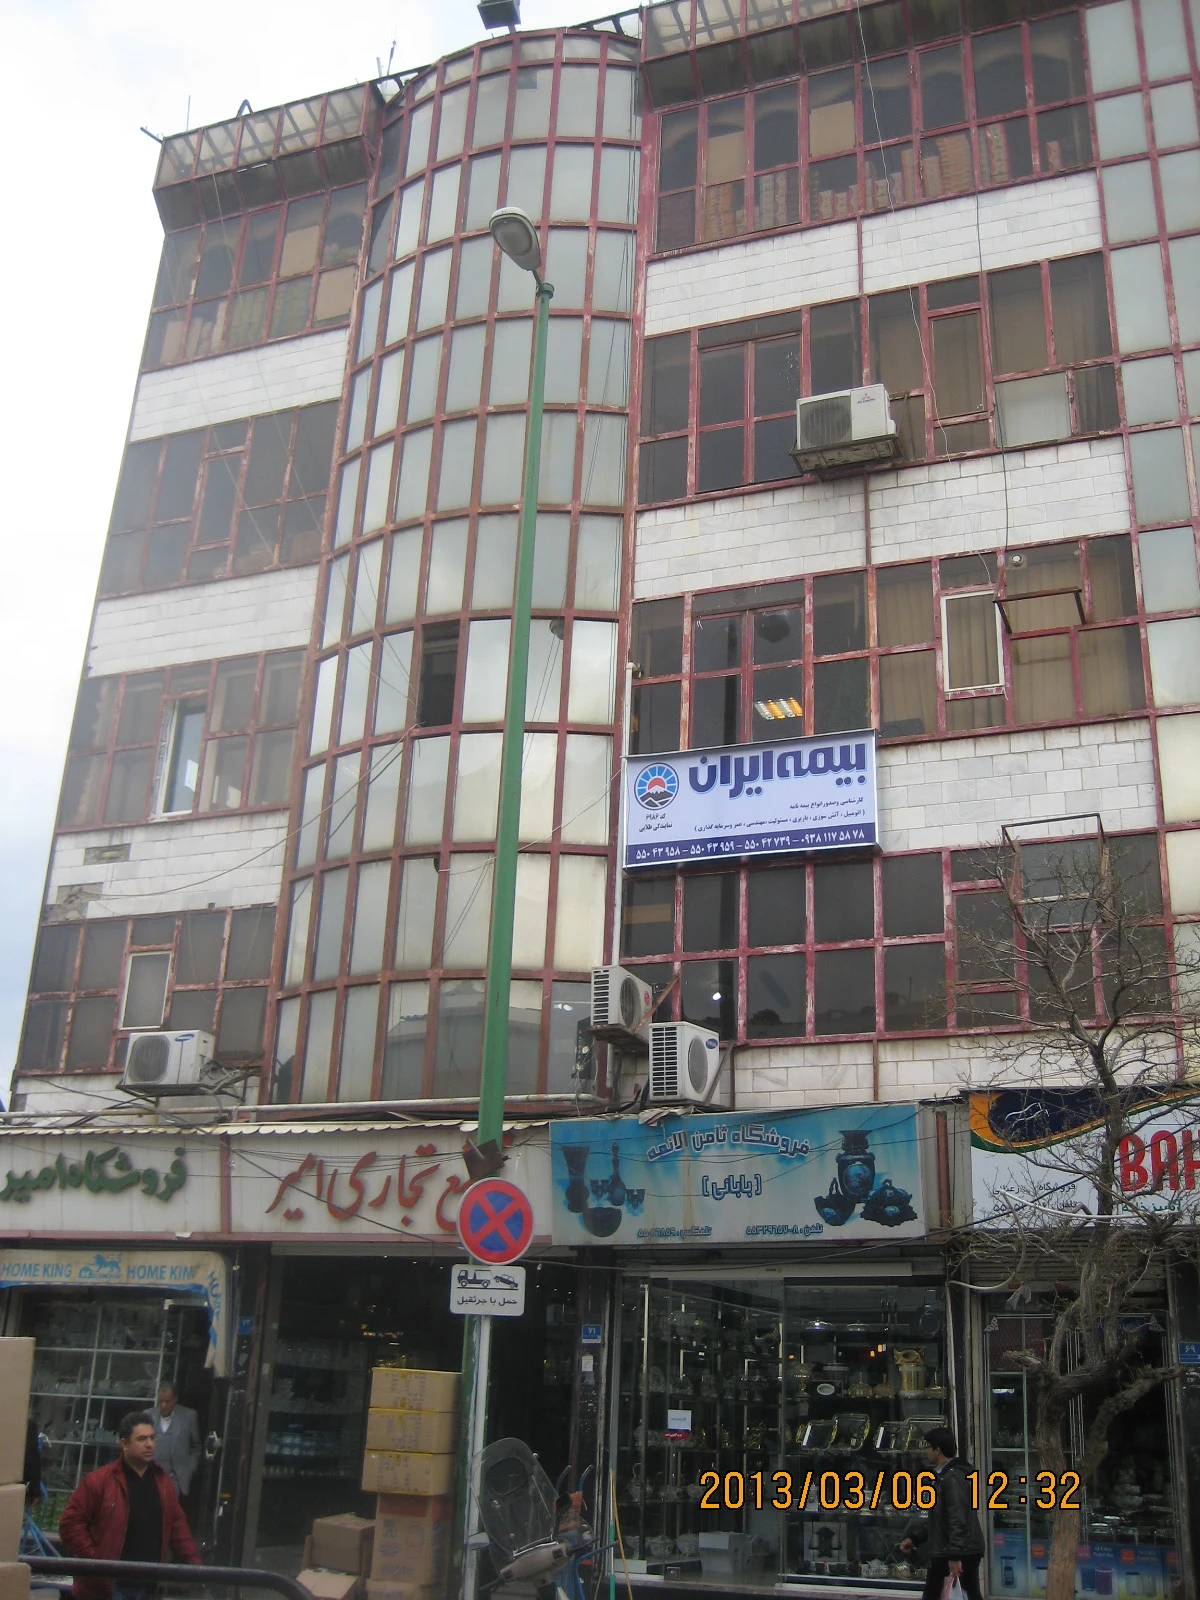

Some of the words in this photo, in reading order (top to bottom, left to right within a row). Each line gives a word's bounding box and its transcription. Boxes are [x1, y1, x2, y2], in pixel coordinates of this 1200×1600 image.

[688, 750, 775, 799] ایران
[776, 743, 867, 787] بیمه
[659, 812, 667, 820] کد
[646, 1129, 690, 1162] الائمه
[690, 1124, 729, 1153] ثامن
[731, 1123, 811, 1159] فروشگاه
[0, 1152, 67, 1204] امیر
[66, 1146, 188, 1203] فروشگاه
[265, 1152, 324, 1221] امیر
[326, 1143, 441, 1228] تجاری
[1, 1262, 39, 1278] HOME
[41, 1263, 73, 1278] KING
[126, 1264, 167, 1280] HOME
[456, 1295, 488, 1306] جرثقیل
[489, 1296, 497, 1306] با
[498, 1297, 518, 1306] حمل
